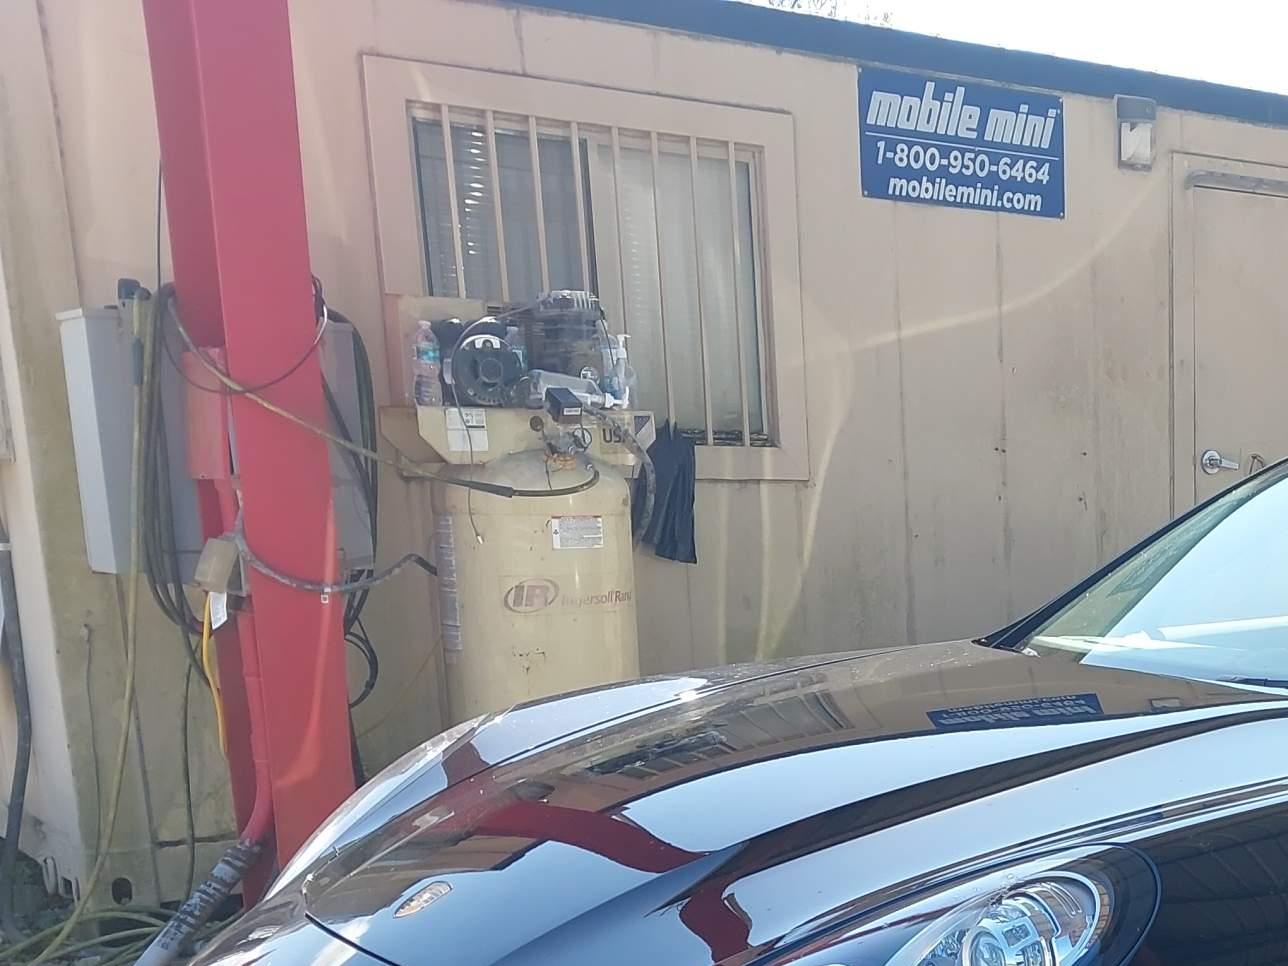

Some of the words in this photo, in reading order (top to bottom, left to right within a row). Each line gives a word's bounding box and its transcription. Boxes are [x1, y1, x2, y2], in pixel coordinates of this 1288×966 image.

[866, 81, 981, 138] mobile
[984, 104, 1057, 148] mini
[876, 140, 1050, 185] 1-800-950-6464
[888, 176, 1042, 211] mobilemini.com
